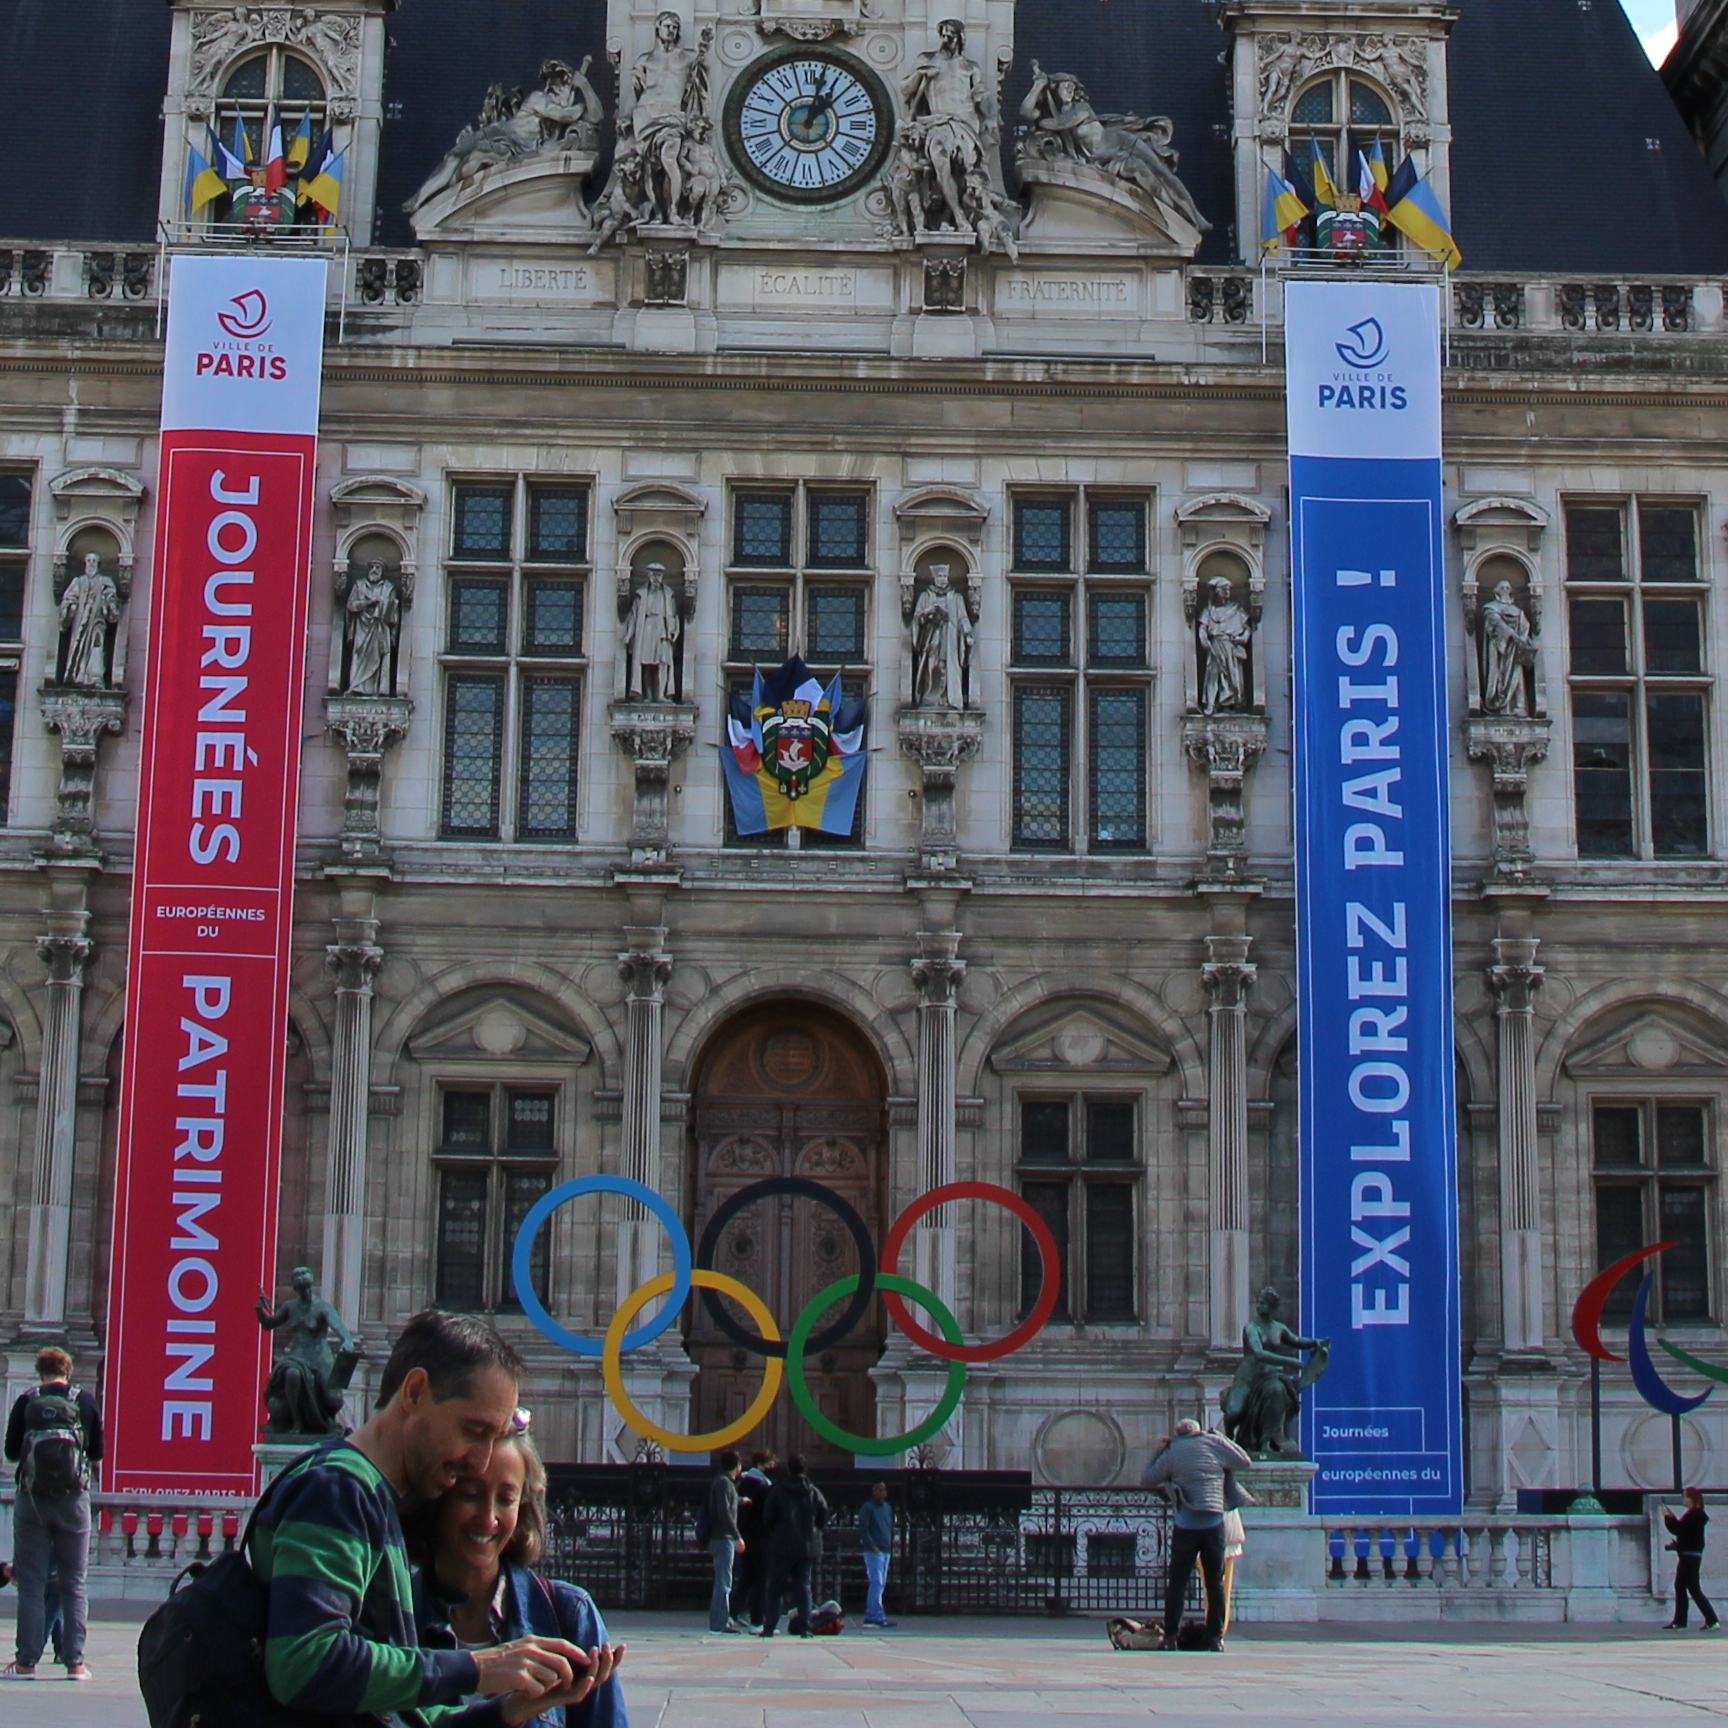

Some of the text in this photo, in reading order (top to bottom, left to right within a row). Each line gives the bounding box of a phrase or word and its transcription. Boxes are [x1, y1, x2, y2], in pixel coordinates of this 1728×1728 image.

[499, 266, 587, 290] LIBERTÉ
[1007, 279, 1127, 301] FRATERNITÉ
[213, 341, 274, 352] VILLE DE
[196, 353, 287, 380] PARIS
[1333, 373, 1393, 382] VILLE DE
[1318, 384, 1407, 410] PARIS
[189, 469, 260, 865] JOURNÉES
[157, 904, 265, 921] EUROPÉENNES
[197, 926, 219, 937] DU
[1336, 570, 1410, 1329] EXPLOREZ PARIS !
[161, 975, 231, 1441] PATRIMOINE
[1323, 1425, 1389, 1438] Journées
[1322, 1467, 1440, 1483] européennes du
